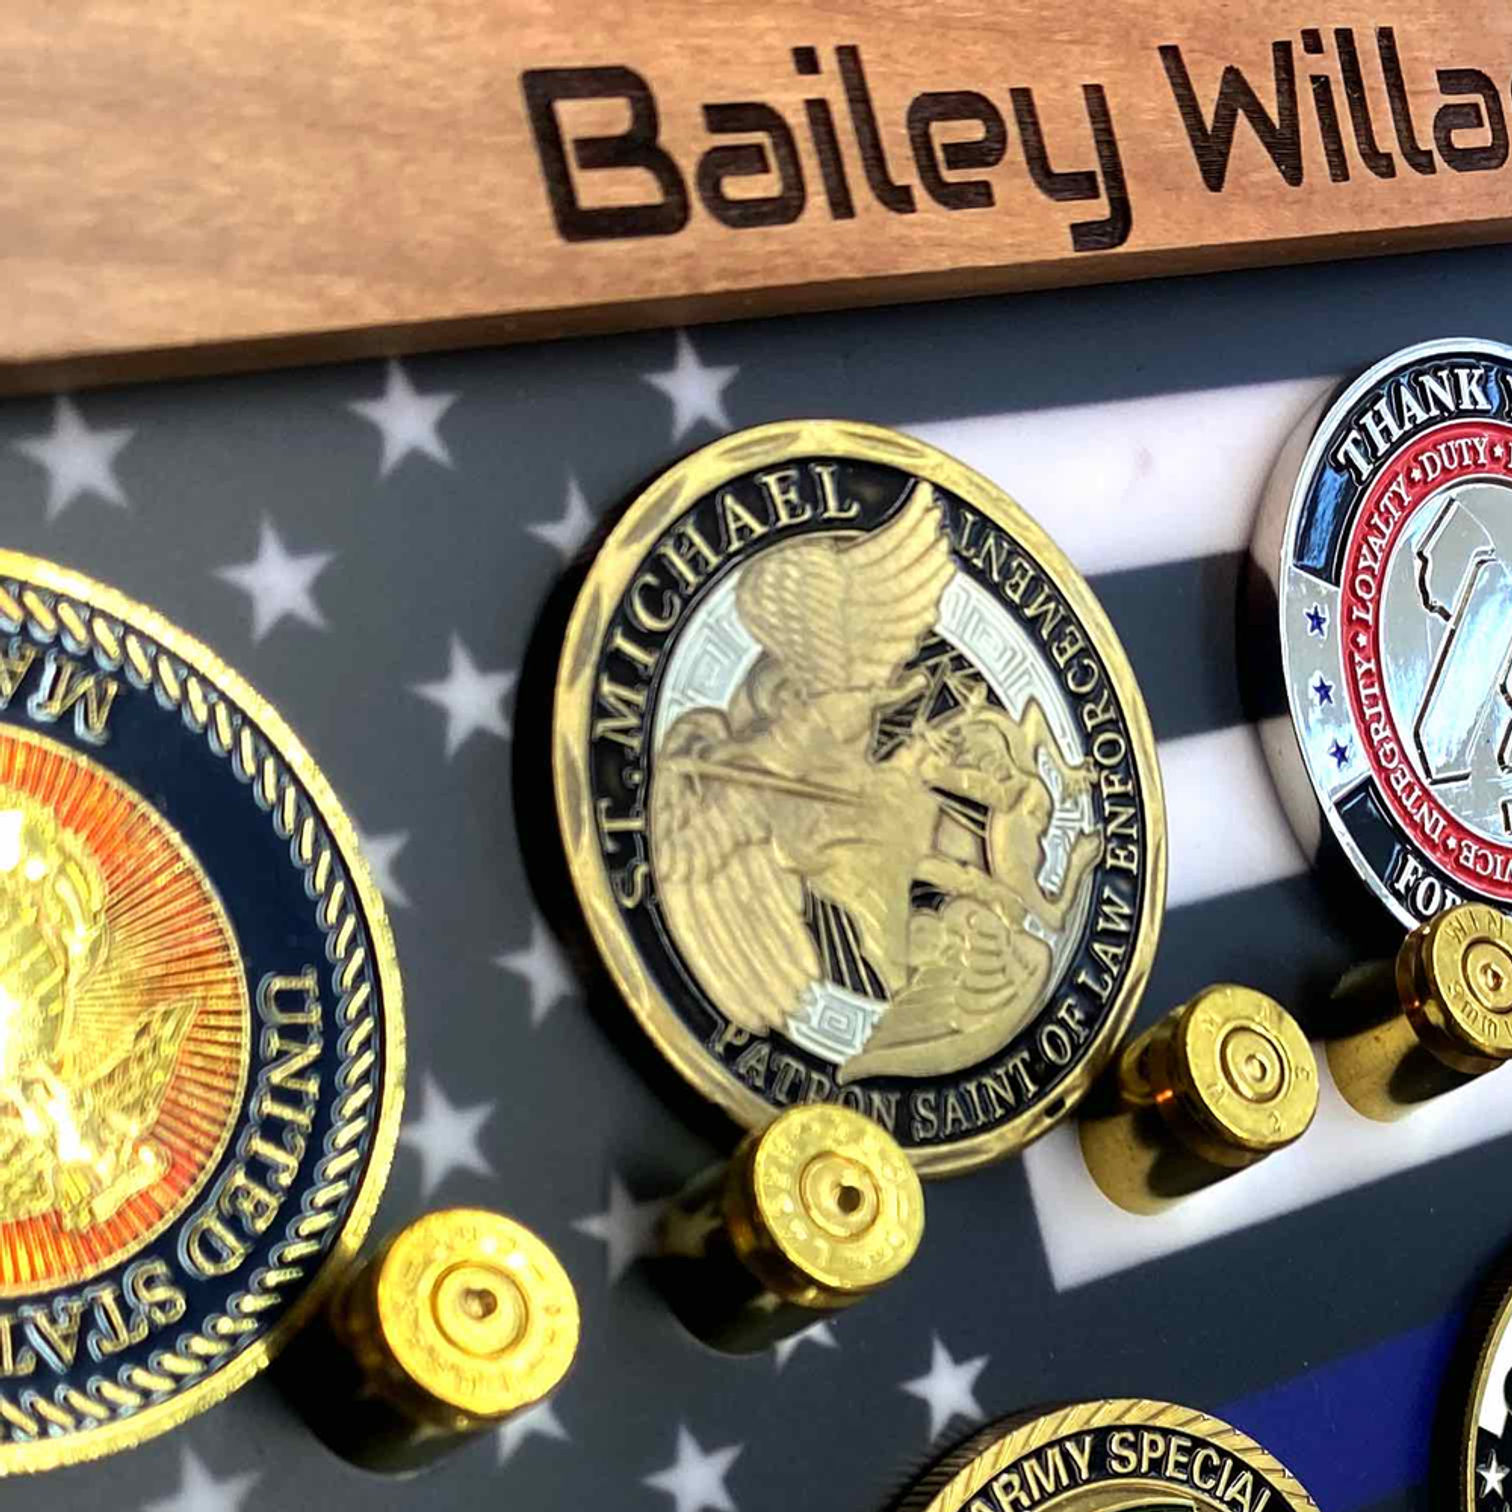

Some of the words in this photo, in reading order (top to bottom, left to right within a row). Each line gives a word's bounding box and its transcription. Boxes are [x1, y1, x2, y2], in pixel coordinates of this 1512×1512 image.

[520, 44, 1132, 252] Bailey
[1337, 367, 1492, 482] THANK
[1419, 437, 1492, 481] DUTY
[596, 461, 860, 745] MICHAEL
[1351, 475, 1414, 624] LOYALTY
[956, 509, 1140, 876] ENFORCEMENT
[1356, 652, 1448, 846] INTEGRITY
[1080, 896, 1137, 1004] LAW
[911, 1051, 1035, 1140] SAINT
[1038, 999, 1096, 1065] OF
[180, 966, 322, 1278] UNITED
